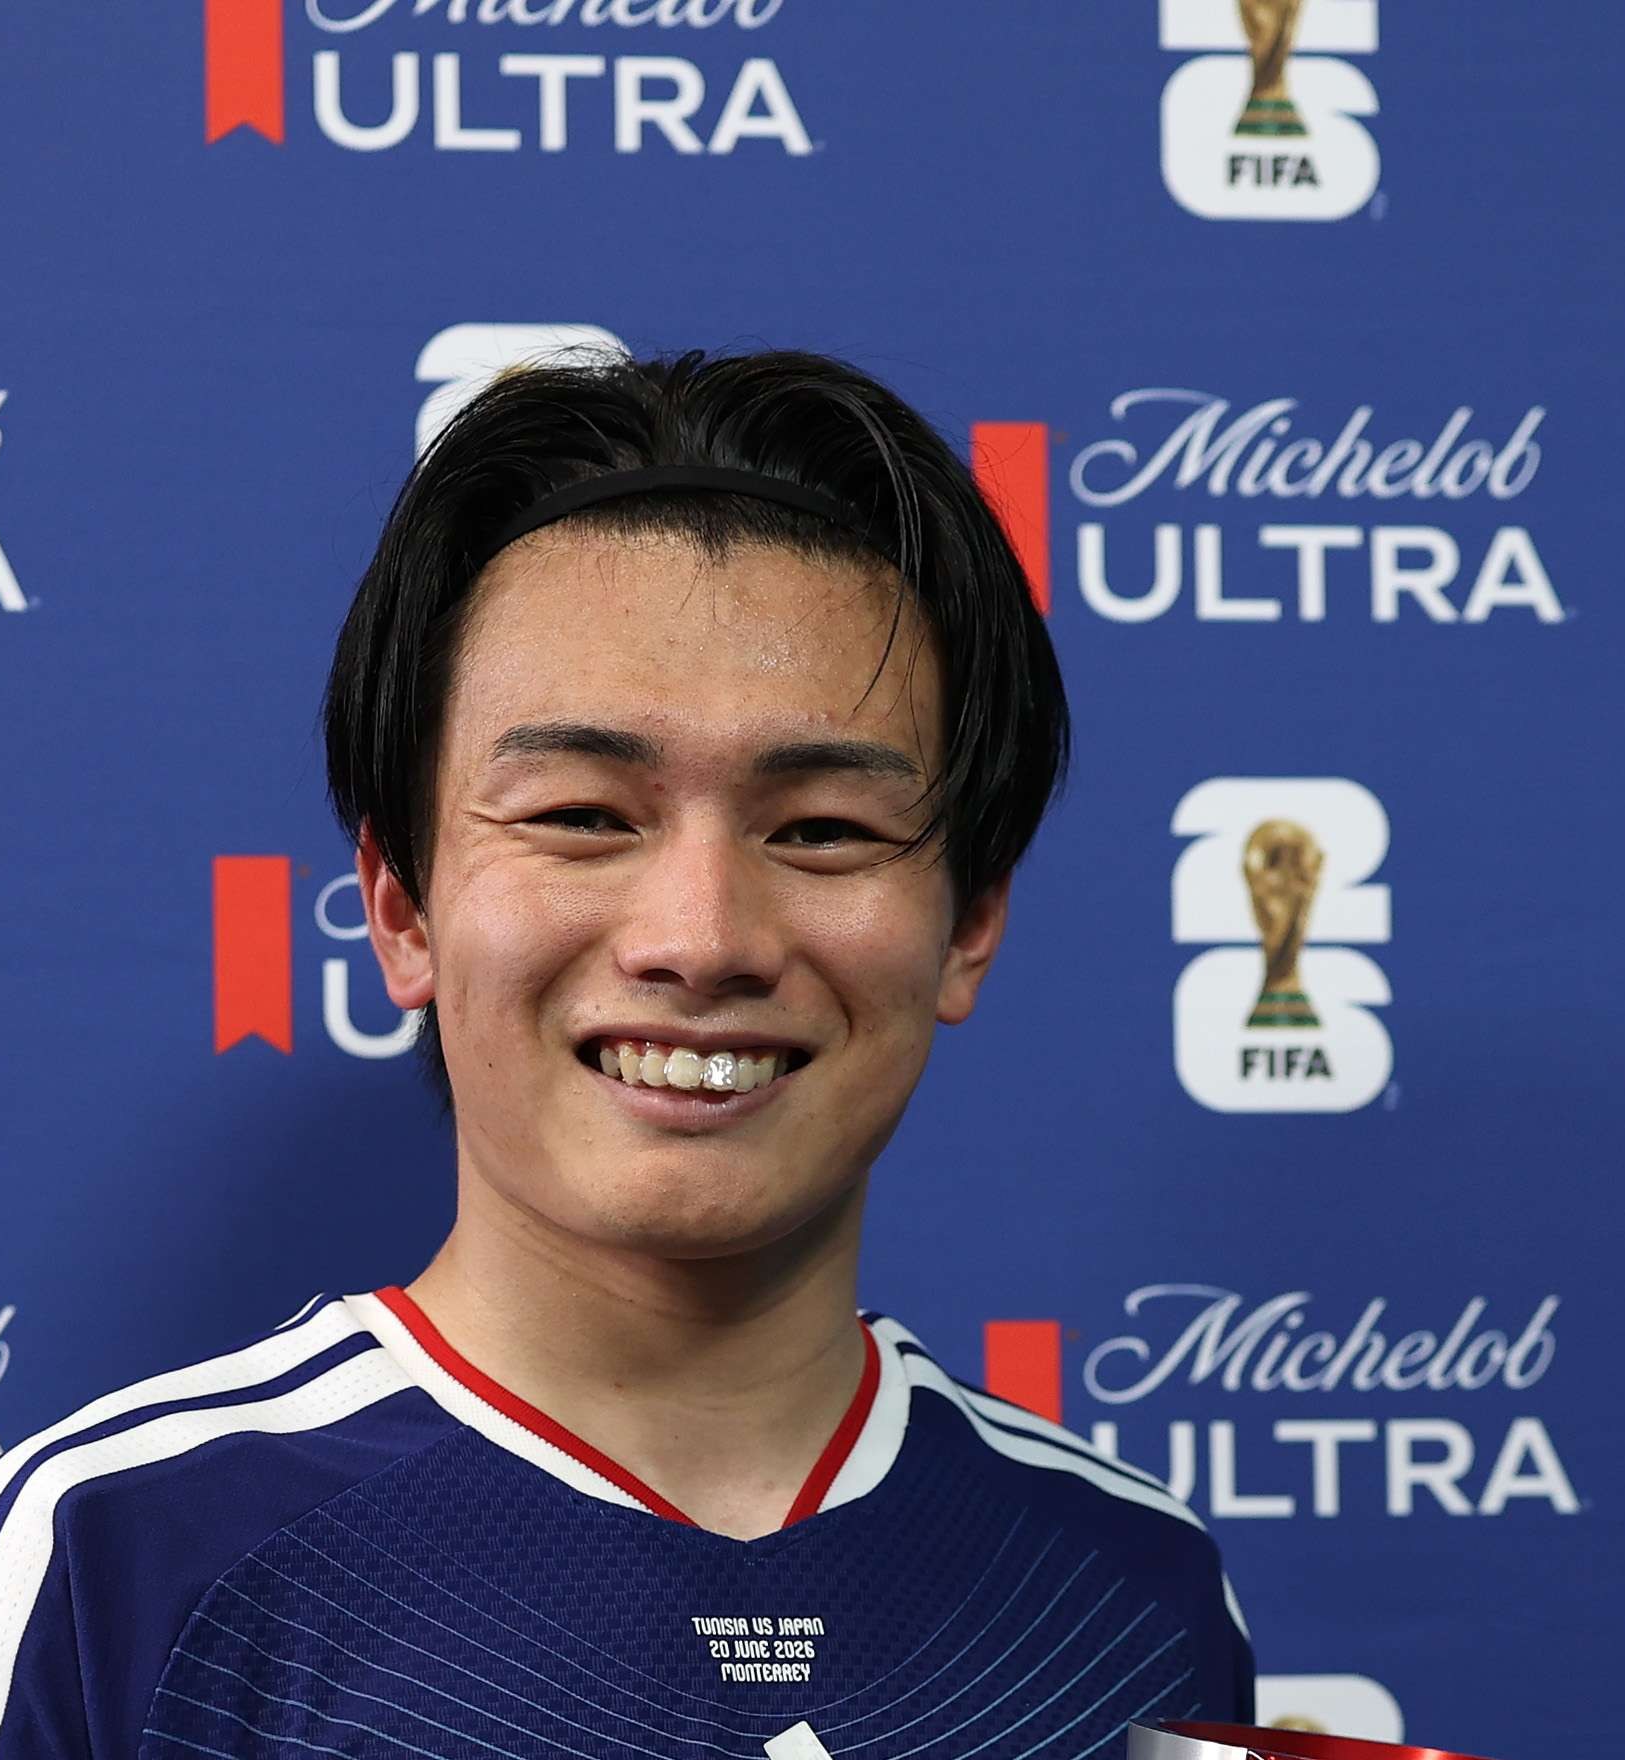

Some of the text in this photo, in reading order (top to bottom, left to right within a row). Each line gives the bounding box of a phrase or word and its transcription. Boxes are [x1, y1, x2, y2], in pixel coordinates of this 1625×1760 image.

[312, 50, 814, 156] ULTRA
[1227, 153, 1319, 188] FIFA
[1069, 389, 1546, 507] Michelob
[1077, 523, 1564, 624] ULTRA
[1239, 1046, 1333, 1080] FIFA
[1083, 1284, 1559, 1405] Michelob
[691, 1616, 750, 1636] TUNISIA
[778, 1617, 824, 1637] JAPAN
[709, 1640, 815, 1659] 20 JUNE 2026
[721, 1663, 811, 1682] MONTERREY
